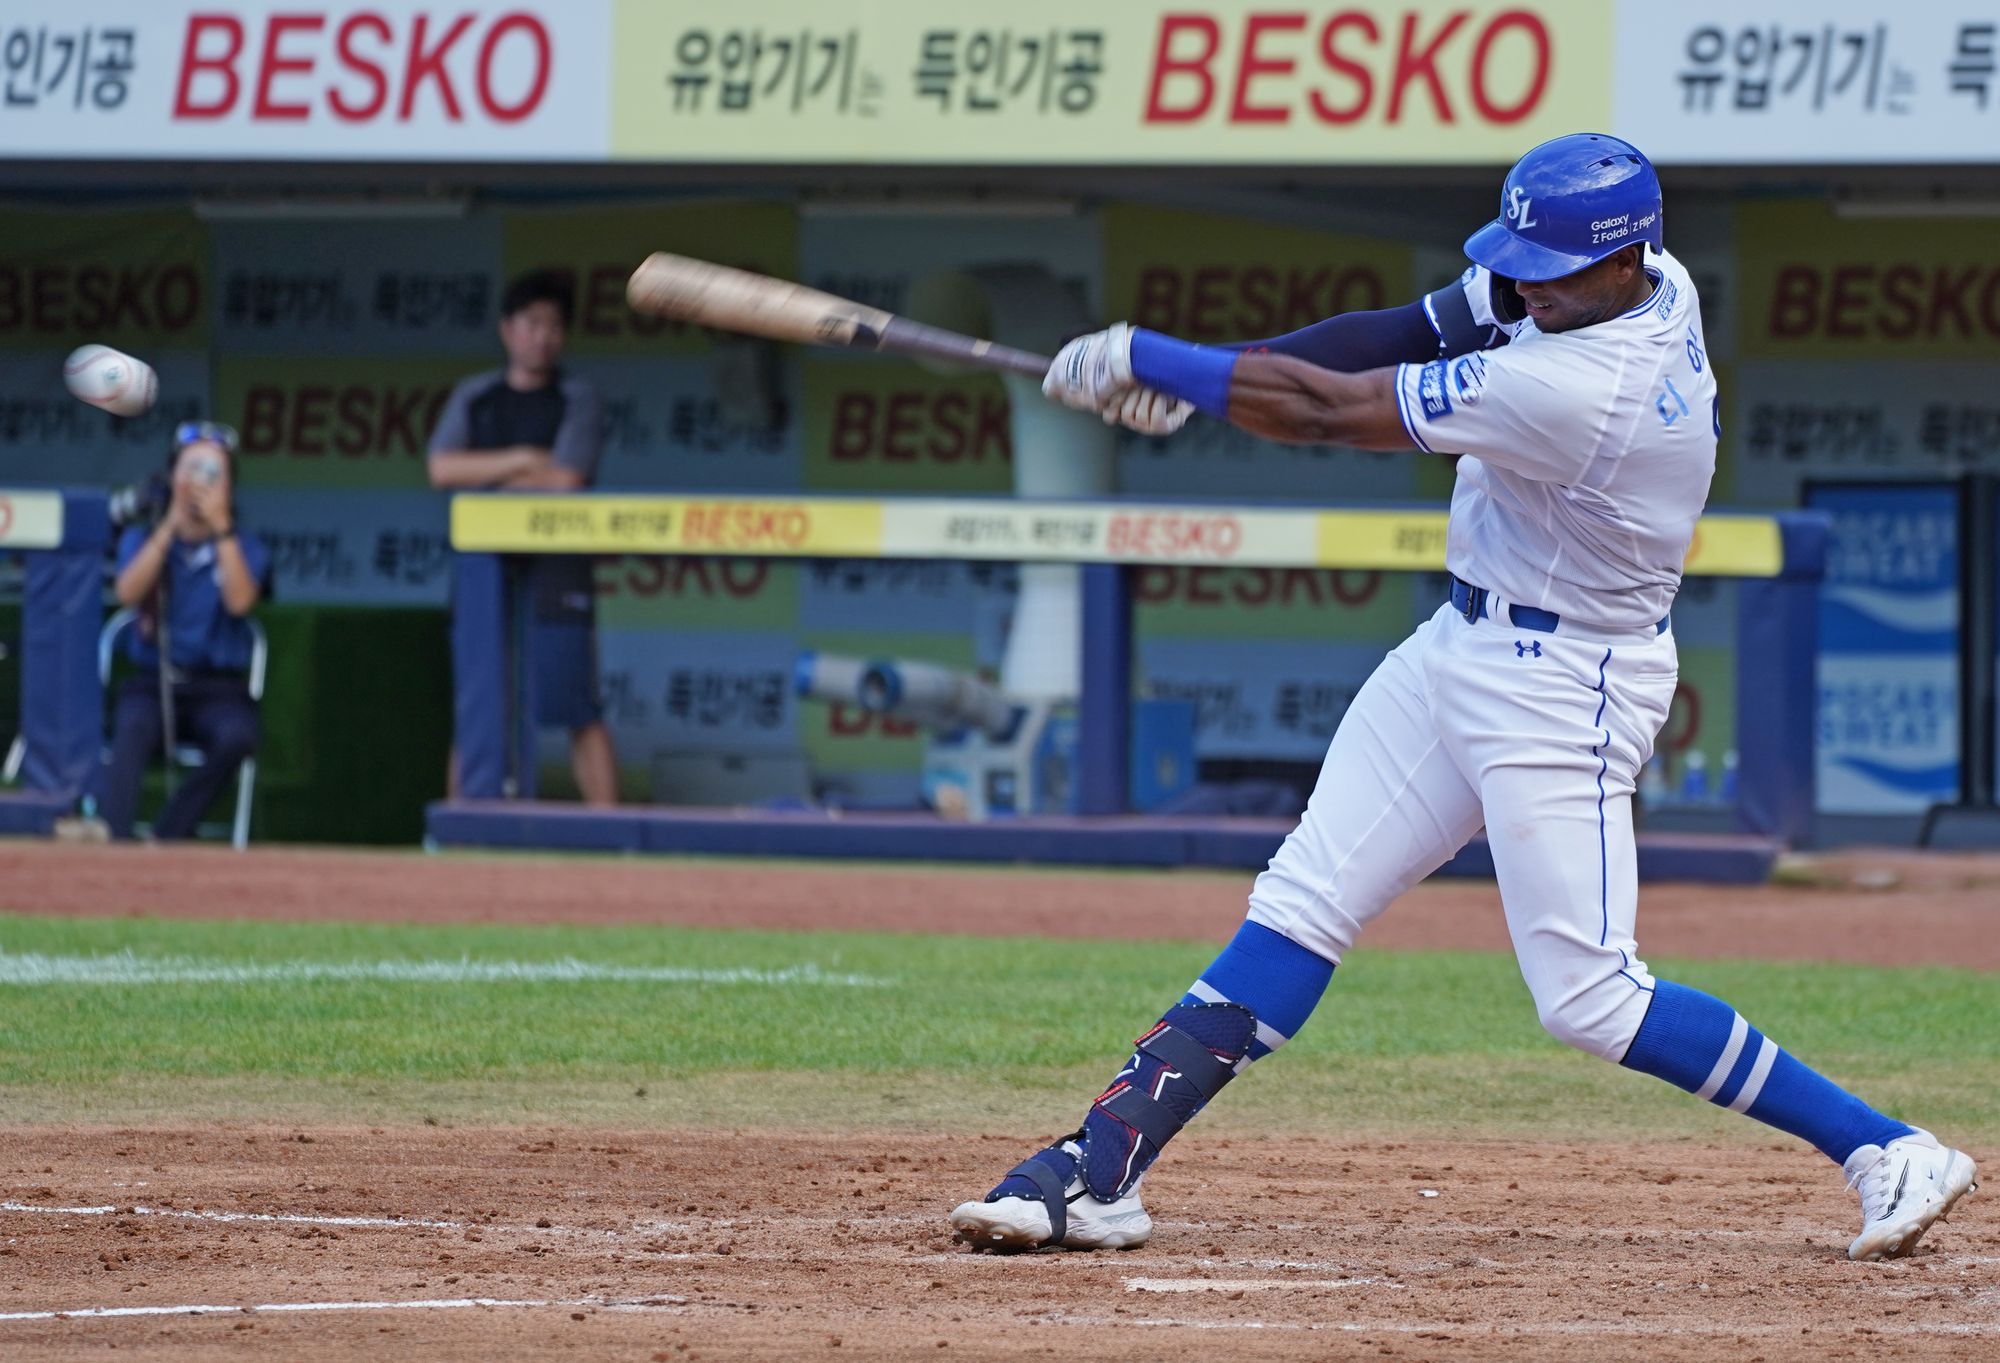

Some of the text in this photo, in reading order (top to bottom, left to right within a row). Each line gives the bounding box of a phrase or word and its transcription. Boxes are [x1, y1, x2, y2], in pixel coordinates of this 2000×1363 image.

[172, 12, 551, 124] BESKO
[1142, 11, 1553, 126] BESKO
[1591, 214, 1629, 231] Galaxy
[1592, 212, 1655, 244] Z Fold6 Z Flip6
[683, 502, 811, 549] BESKO
[1106, 513, 1242, 556] BESKO
